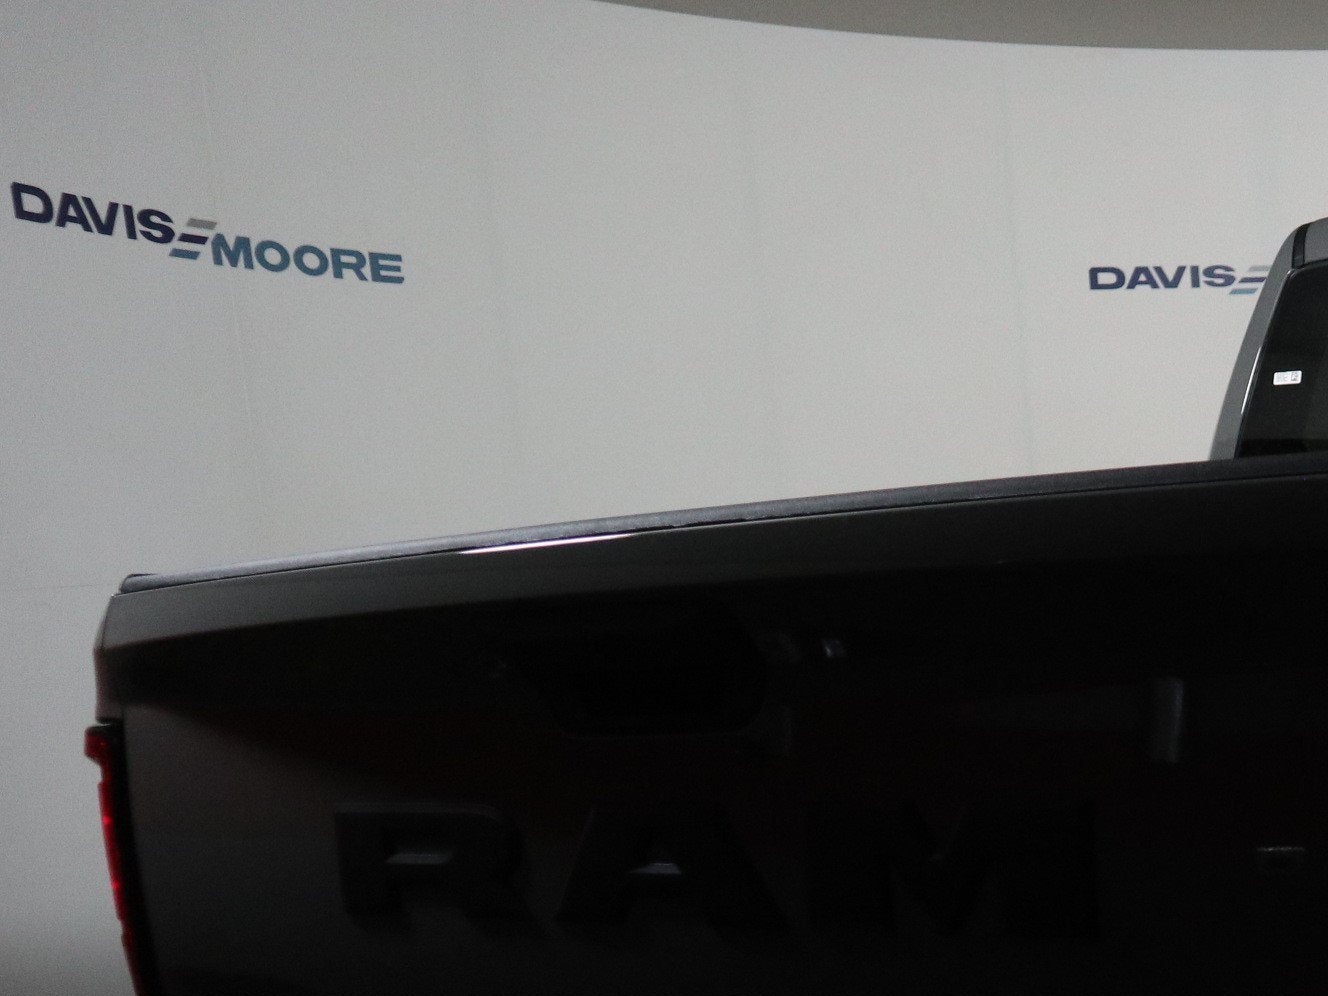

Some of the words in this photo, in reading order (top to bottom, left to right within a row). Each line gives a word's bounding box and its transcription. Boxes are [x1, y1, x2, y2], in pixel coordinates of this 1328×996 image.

[10, 181, 175, 245] DAVIS
[210, 232, 405, 285] MOORE
[1088, 265, 1236, 290] DAVIS
[333, 798, 1102, 940] RAM
